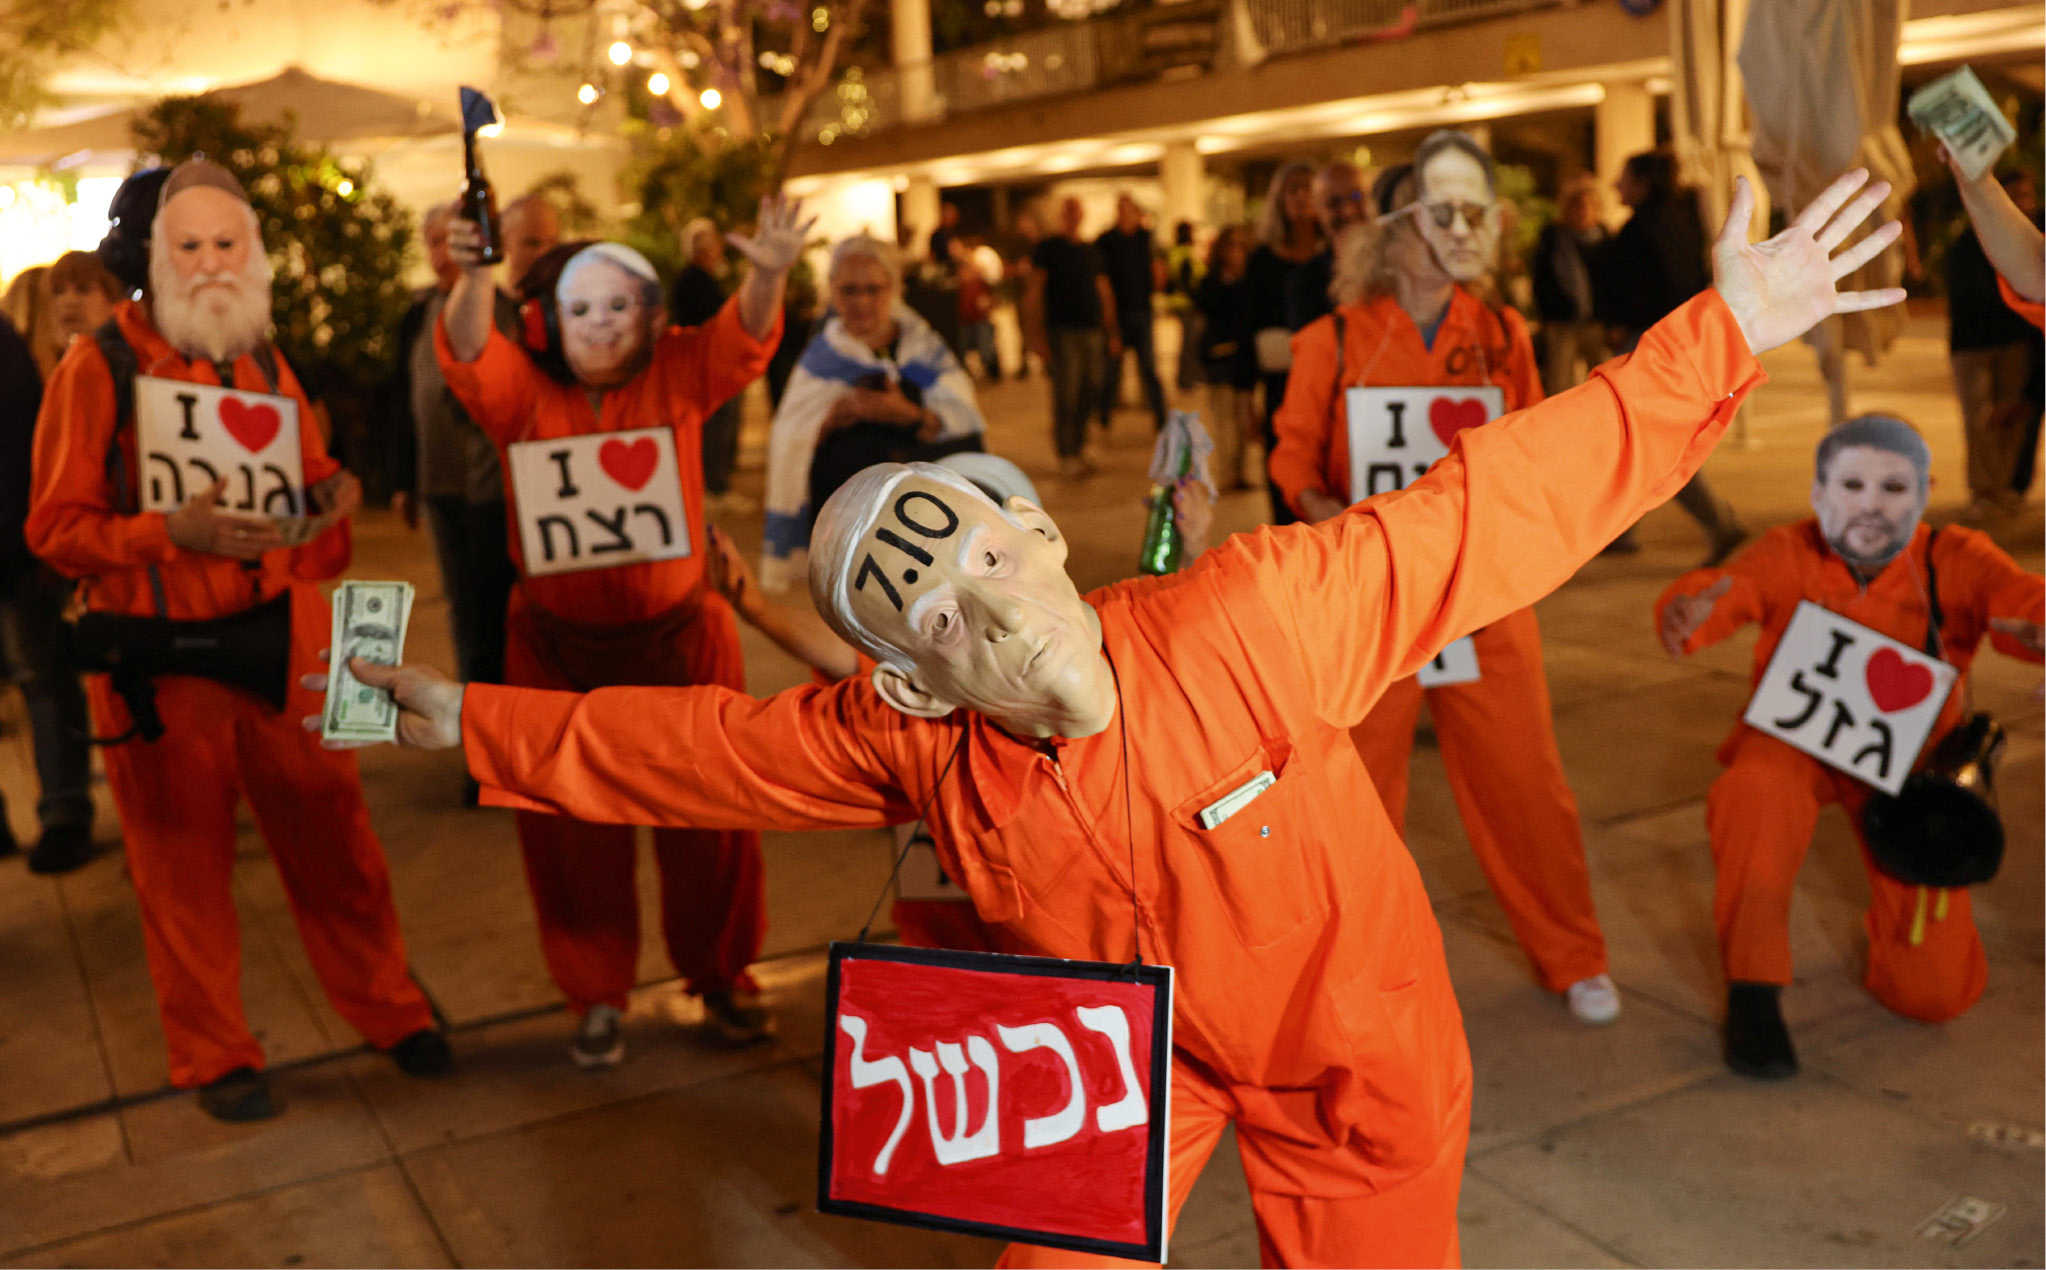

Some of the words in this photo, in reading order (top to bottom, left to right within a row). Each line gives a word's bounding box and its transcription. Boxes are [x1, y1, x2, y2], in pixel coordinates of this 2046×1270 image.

[176, 393, 200, 440] I
[1386, 401, 1406, 449] I
[549, 450, 580, 498] I
[537, 504, 673, 561] רצח
[855, 491, 959, 612] 7.10
[1814, 629, 1855, 679] I
[1773, 669, 1894, 778] גזל
[840, 1005, 1148, 1175] נכשל
